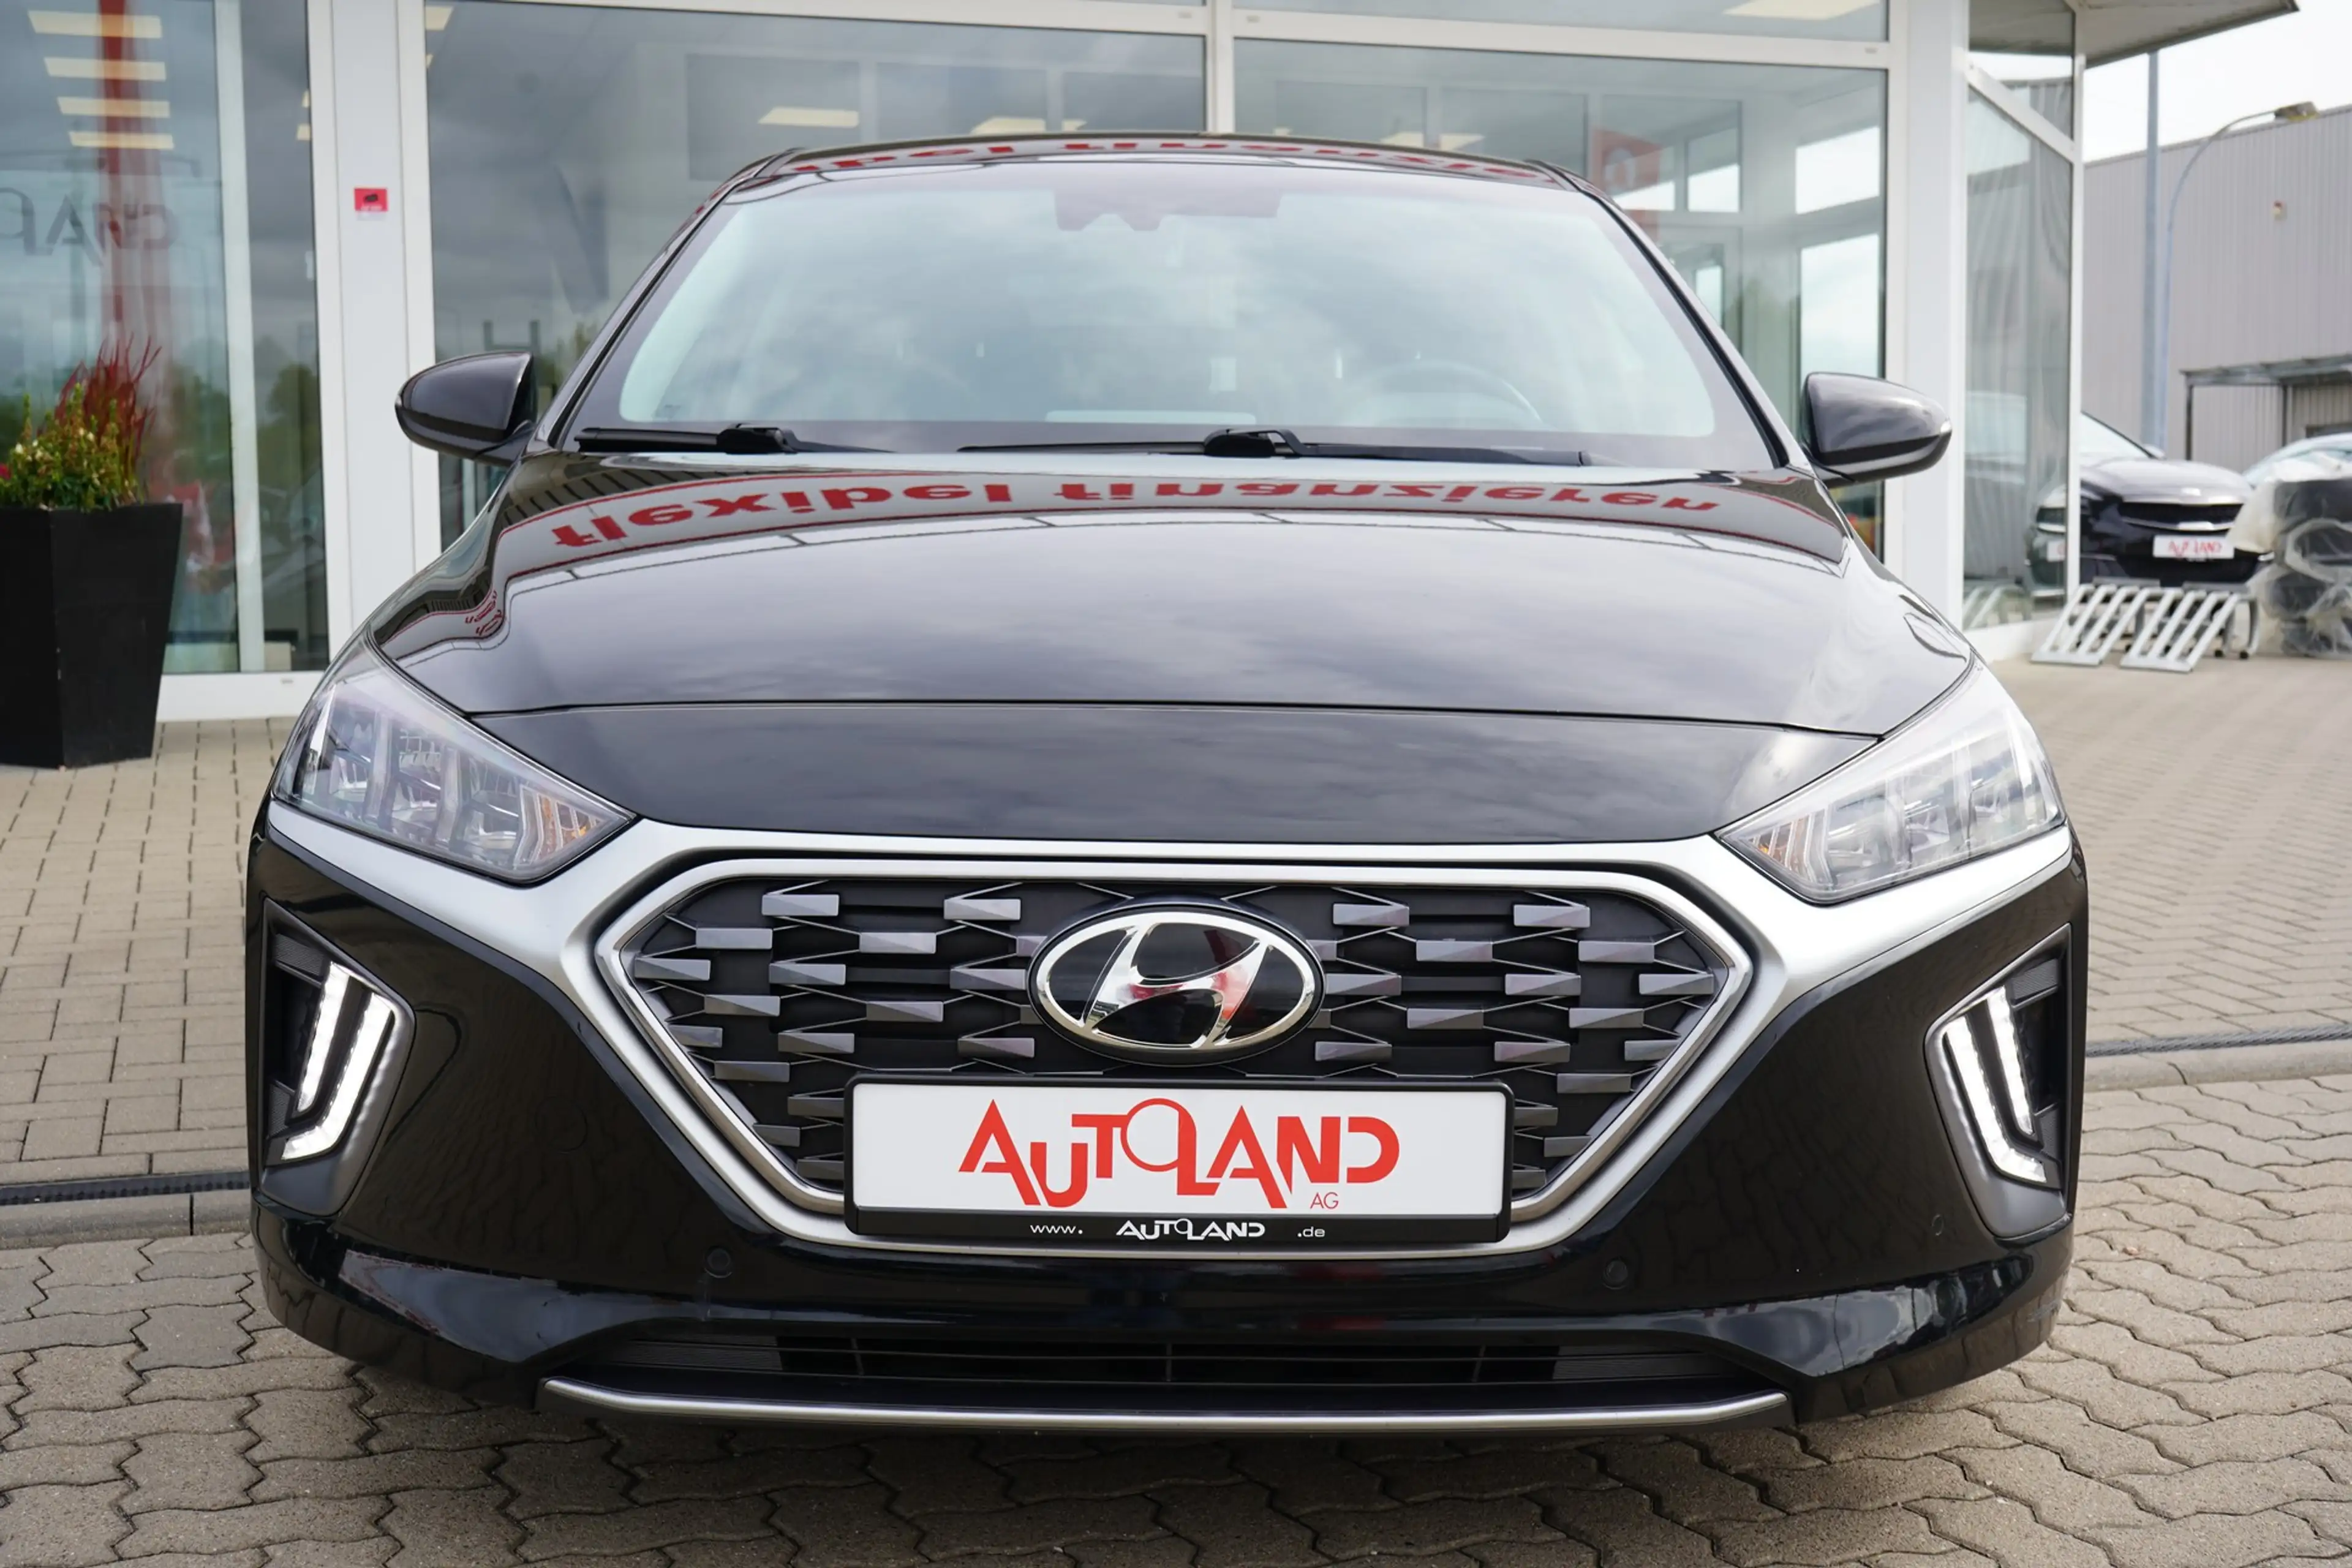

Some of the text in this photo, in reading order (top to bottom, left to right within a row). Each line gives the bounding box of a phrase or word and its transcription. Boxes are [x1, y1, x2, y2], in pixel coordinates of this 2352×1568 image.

[959, 1098, 1400, 1208] AUTOLAND
[1310, 1192, 1340, 1209] AG
[1030, 1218, 1325, 1241] www. AUTOLAND .de
